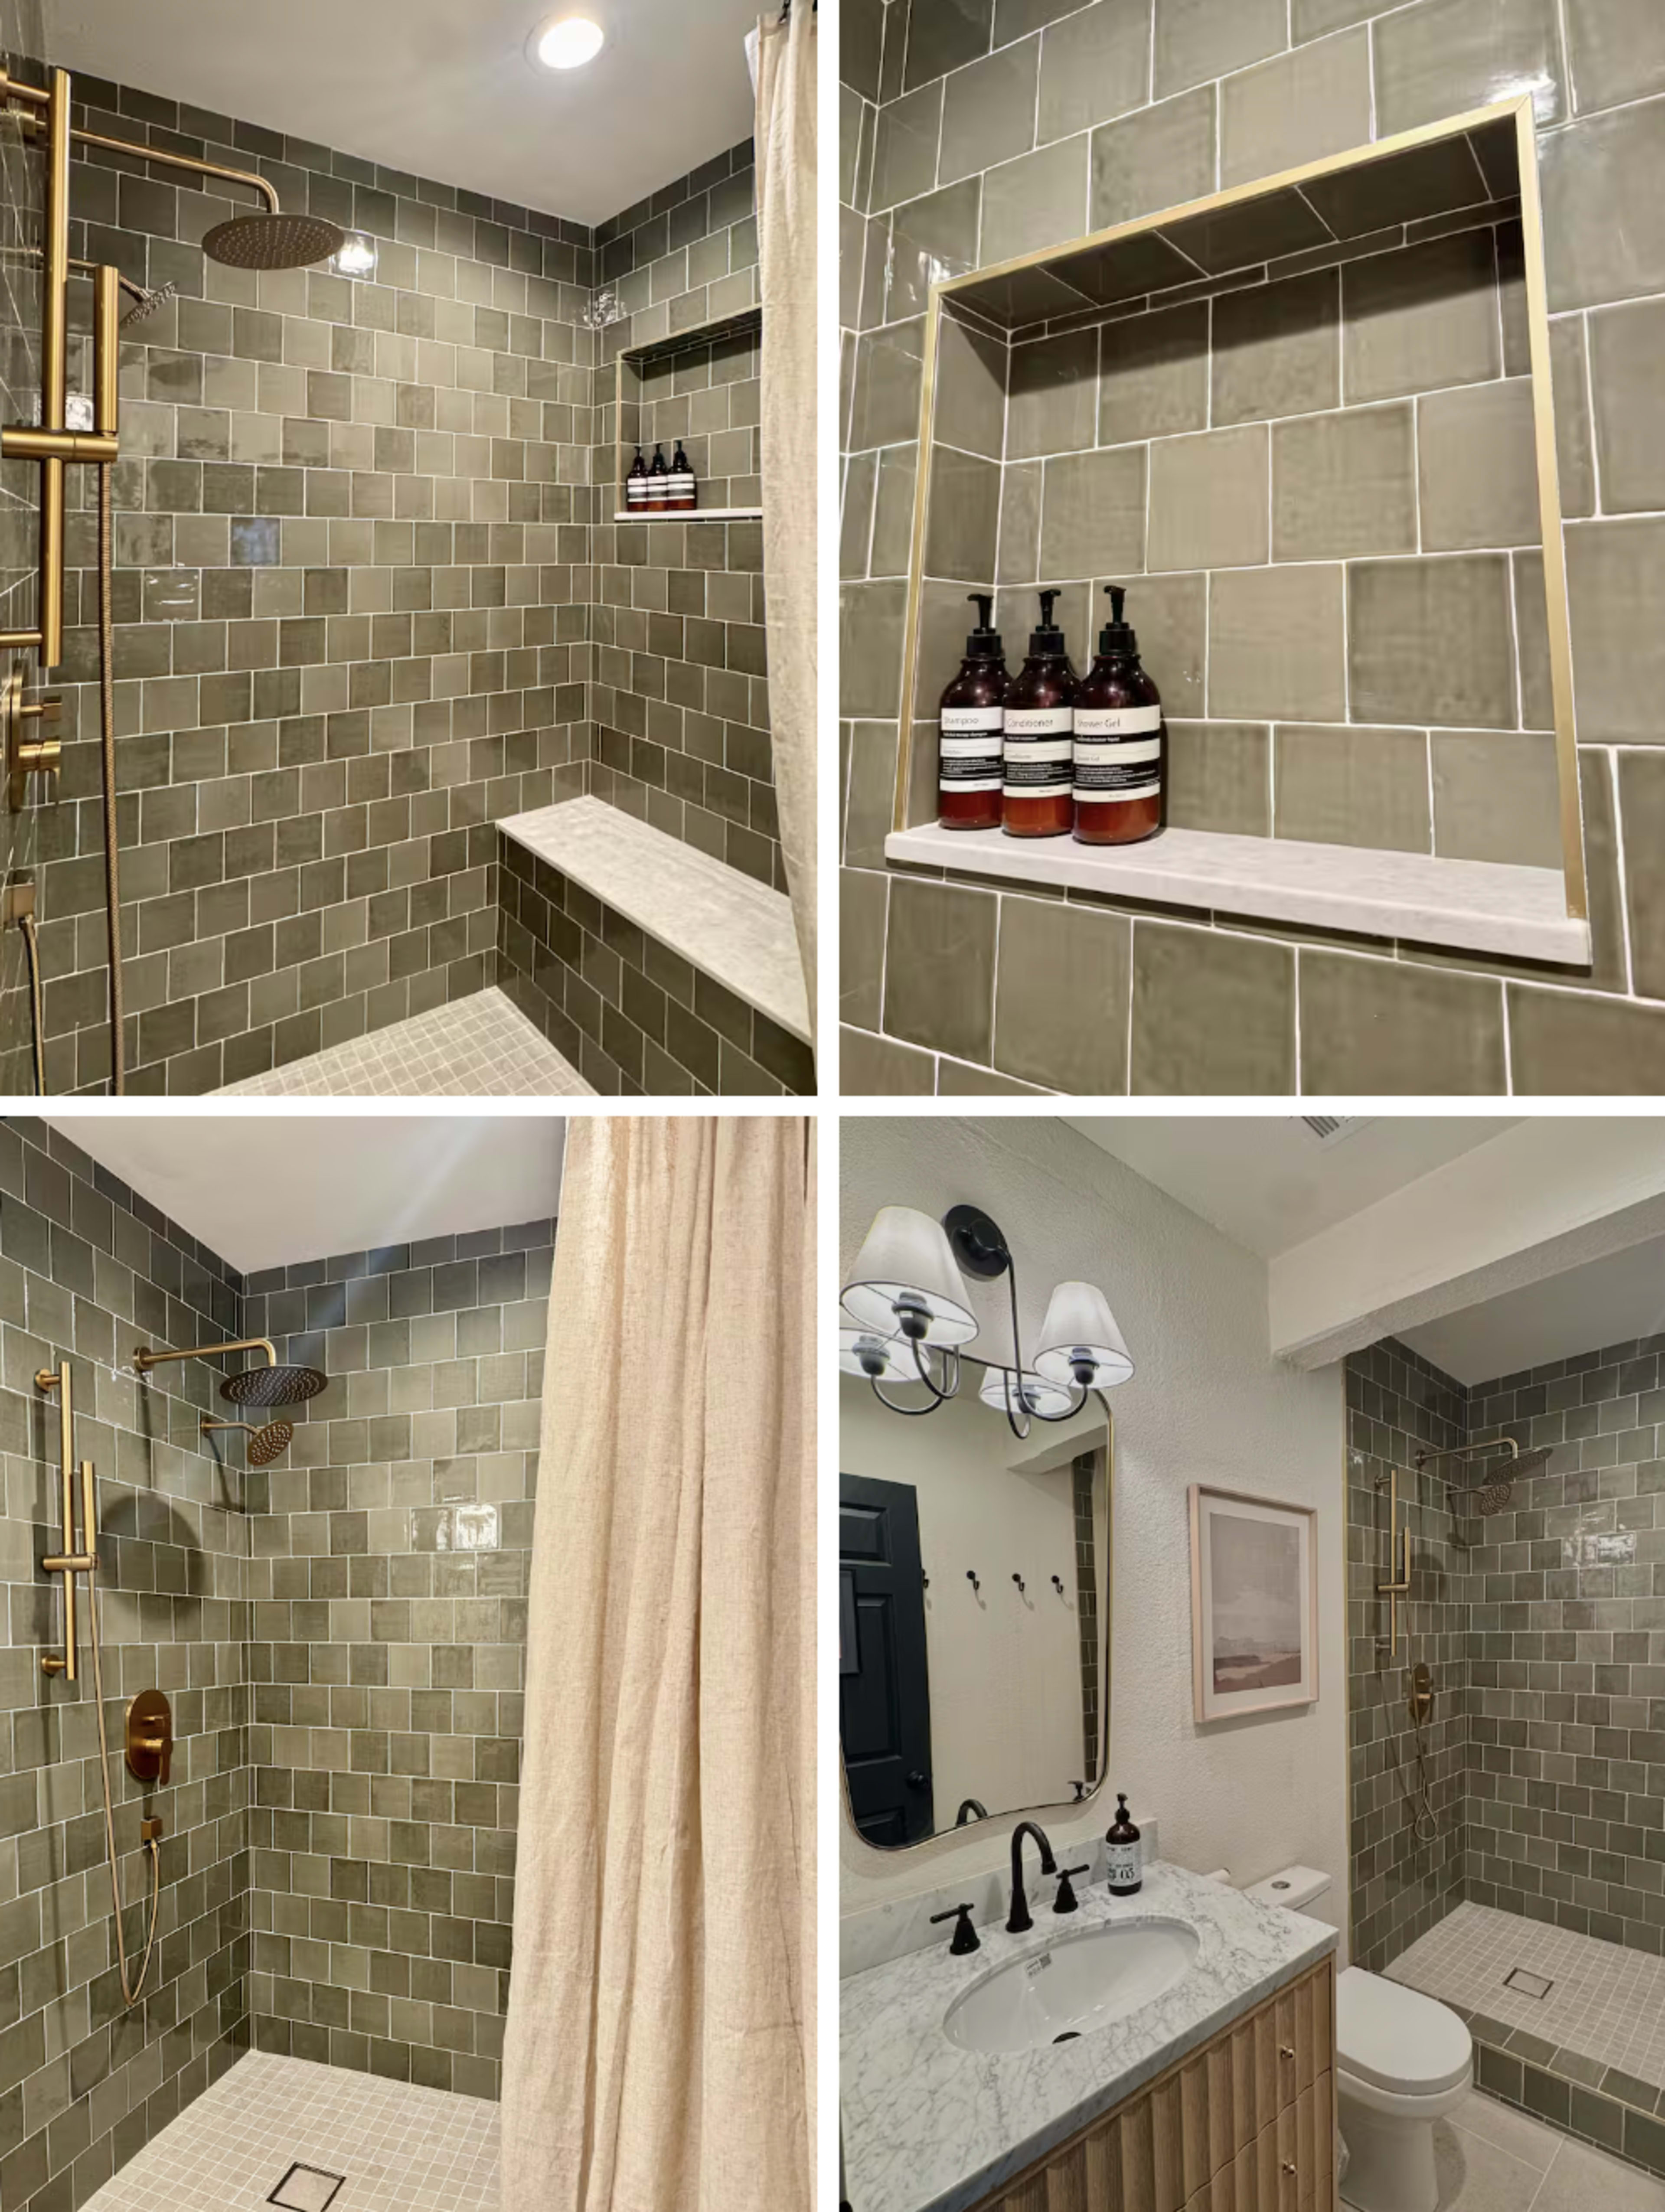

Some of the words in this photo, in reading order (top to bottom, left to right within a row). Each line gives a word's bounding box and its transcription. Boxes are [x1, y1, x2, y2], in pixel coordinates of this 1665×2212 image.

[1007, 718, 1053, 727] Conditioner
[1077, 718, 1103, 727] Shower
[1104, 717, 1120, 727] Gel
